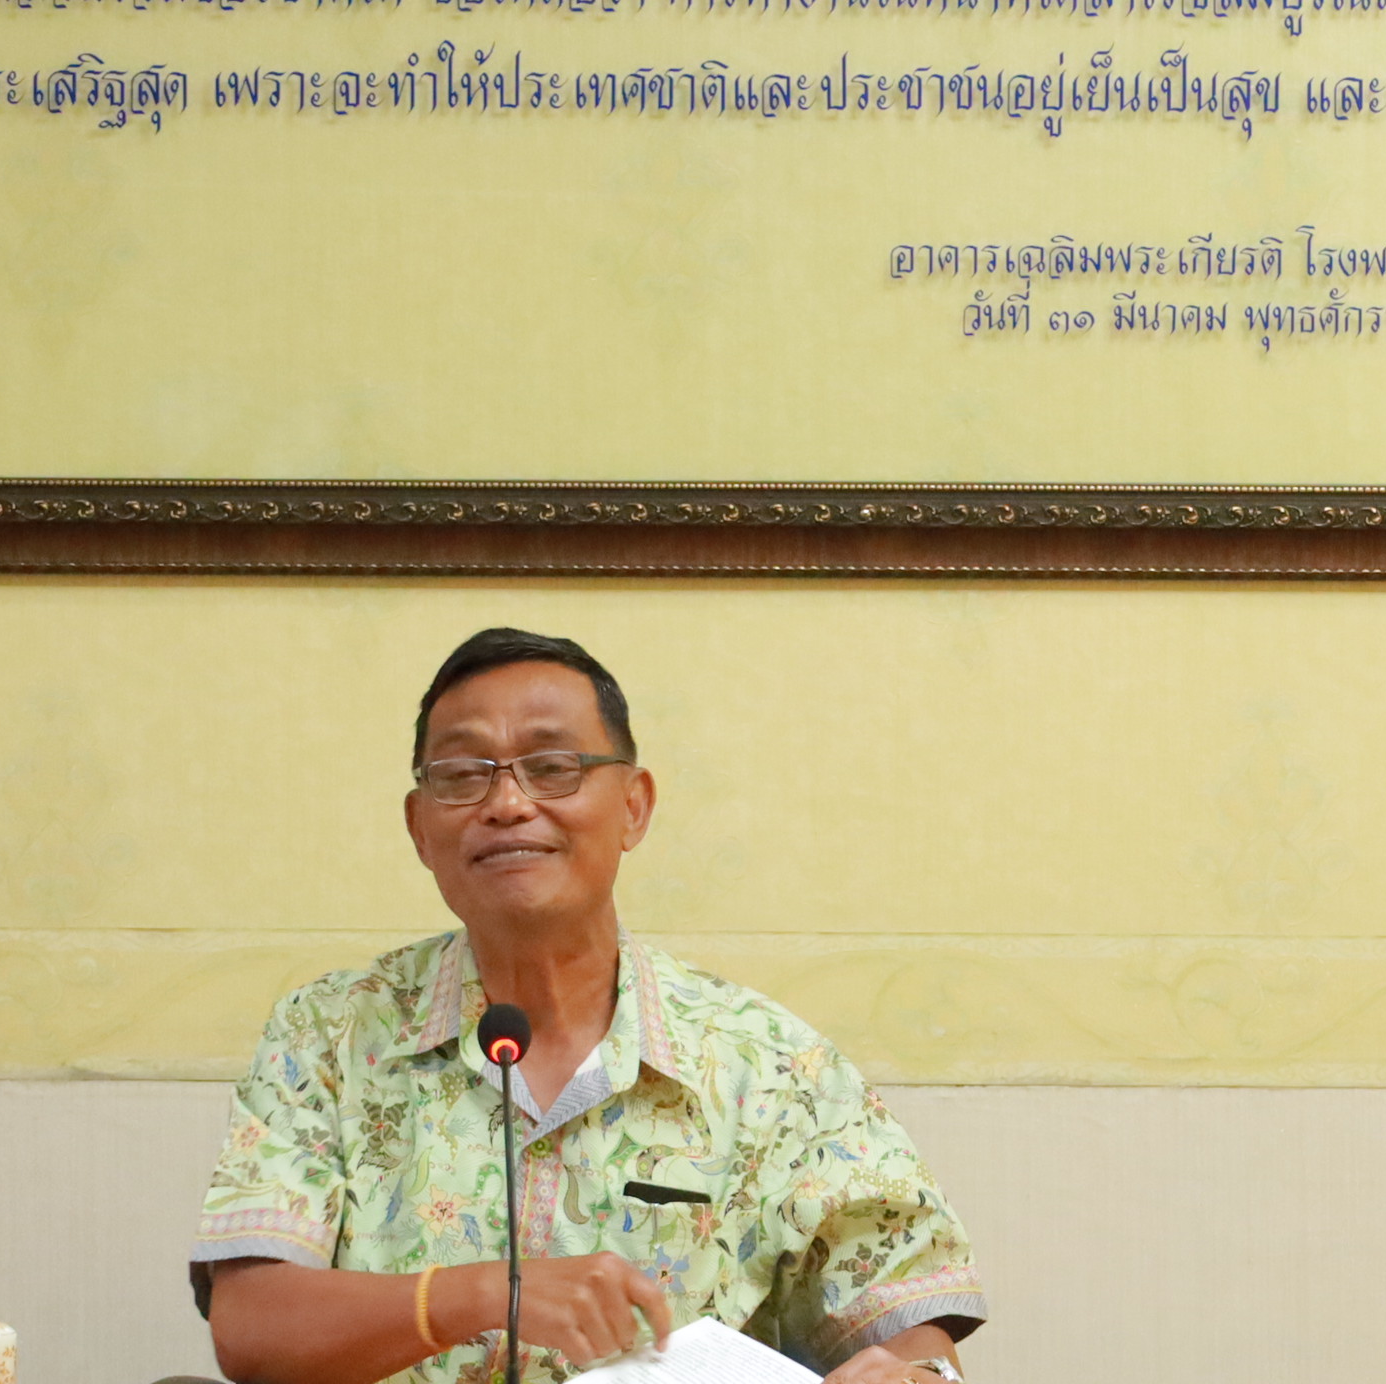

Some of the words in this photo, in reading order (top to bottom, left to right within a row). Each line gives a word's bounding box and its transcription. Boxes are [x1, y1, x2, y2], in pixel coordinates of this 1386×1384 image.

[213, 40, 1283, 142] เพราะจะทำให้ประเทศชาติและประชาชนอยู่เย็นเป็นสุข
[889, 236, 1283, 281] อาคารเฉลิมพระเกียรติ
[963, 280, 1031, 336] วันที่
[1049, 310, 1095, 335] ๓๑
[1112, 290, 1228, 336] มีนาคม
